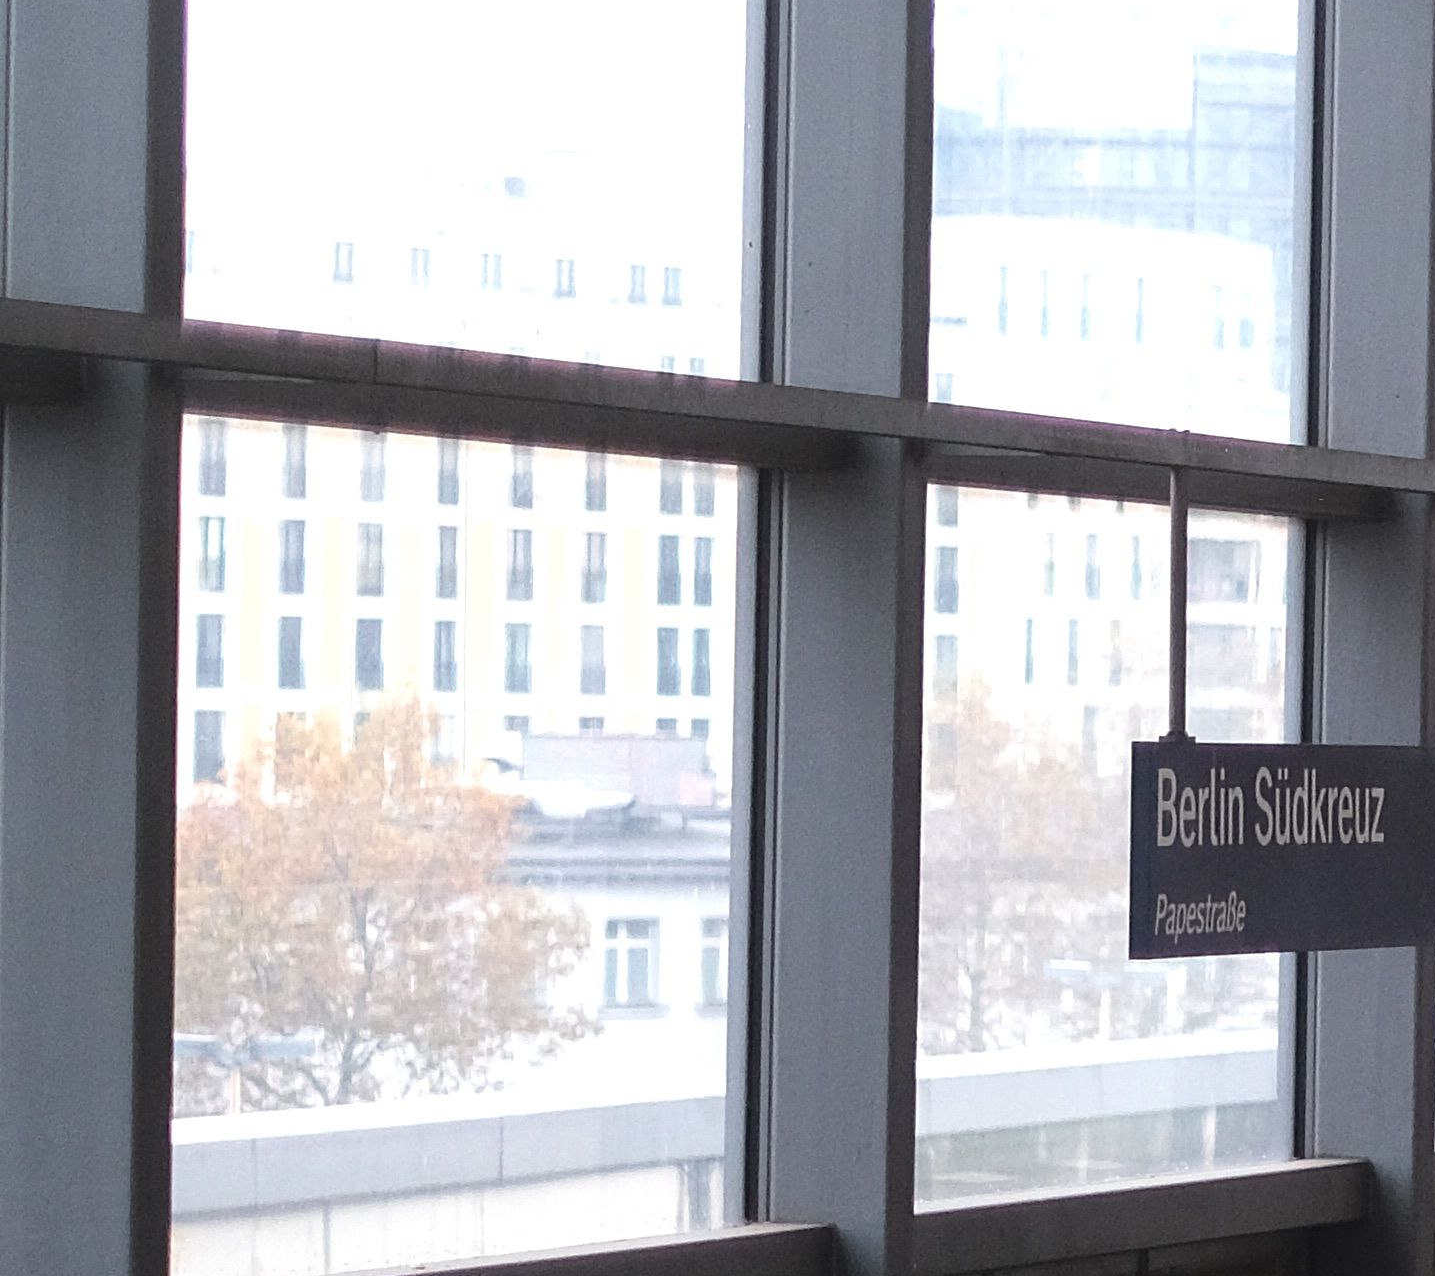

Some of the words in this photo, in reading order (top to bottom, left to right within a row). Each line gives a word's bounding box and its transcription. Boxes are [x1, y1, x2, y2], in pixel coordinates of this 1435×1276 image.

[1157, 767, 1245, 847] Berlin
[1254, 766, 1385, 846] Südkreuz
[1155, 891, 1247, 944] Papestraße
